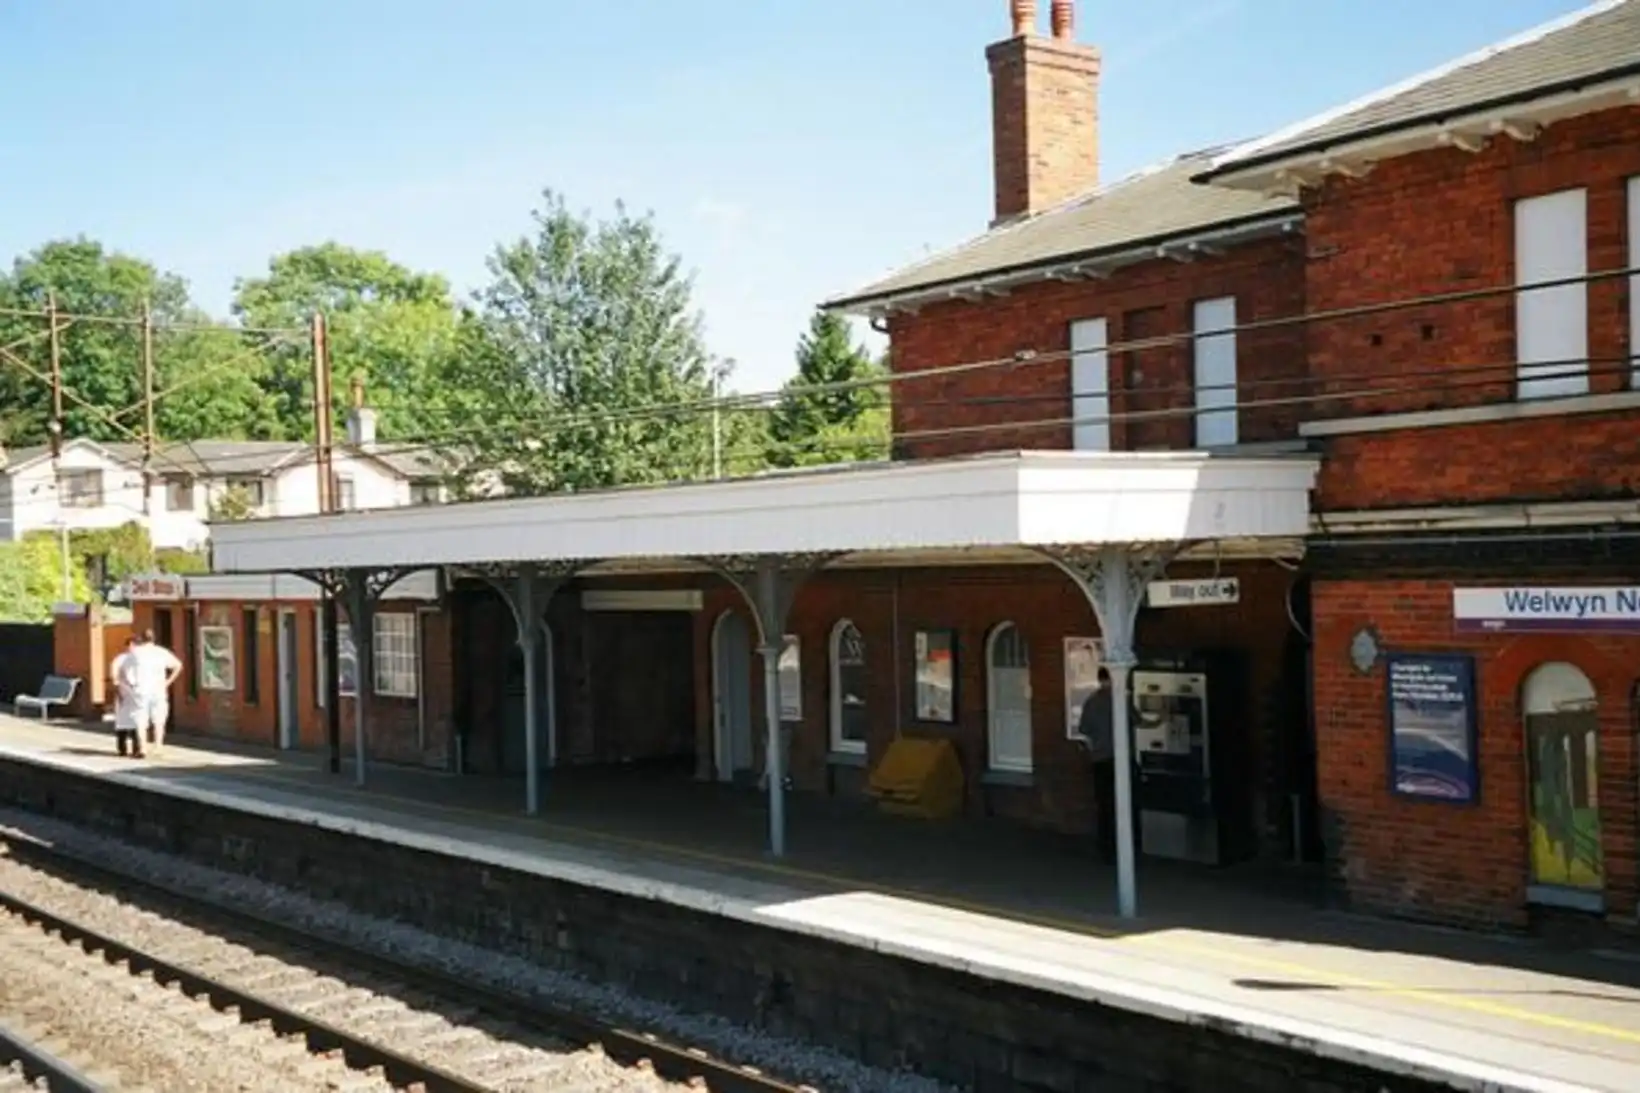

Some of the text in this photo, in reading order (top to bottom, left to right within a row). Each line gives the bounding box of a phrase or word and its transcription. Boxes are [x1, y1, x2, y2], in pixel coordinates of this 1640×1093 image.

[1199, 583, 1220, 598] out
[1504, 589, 1640, 617] Welwyn N
